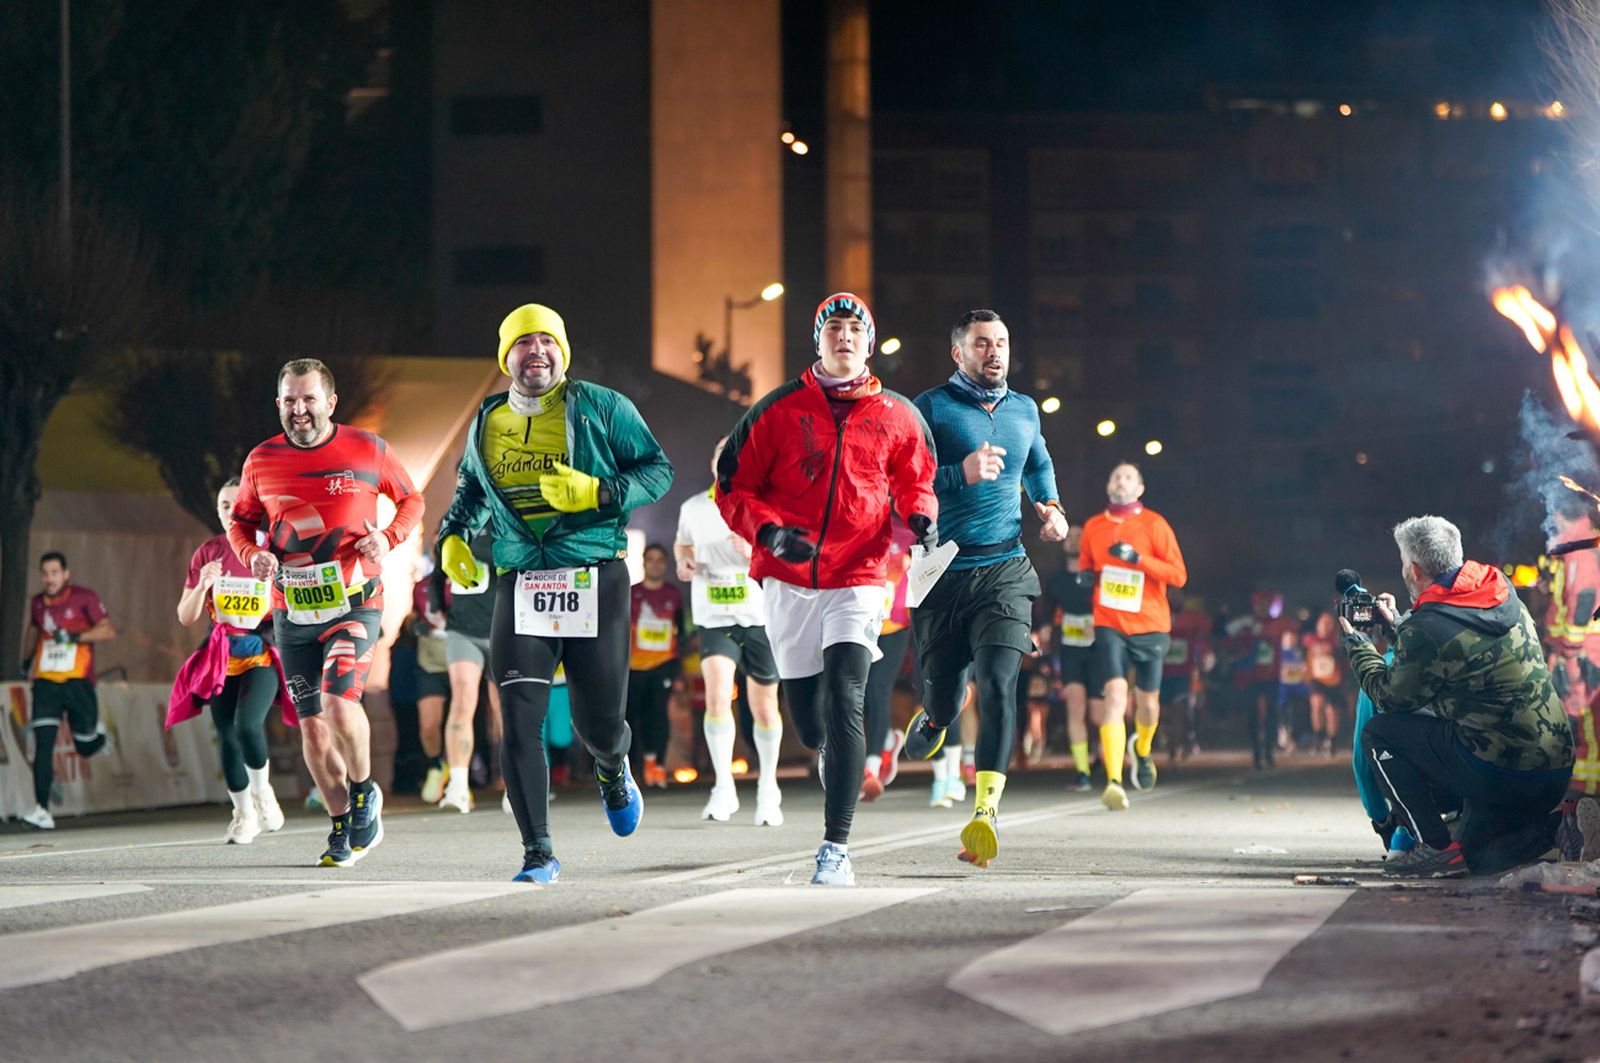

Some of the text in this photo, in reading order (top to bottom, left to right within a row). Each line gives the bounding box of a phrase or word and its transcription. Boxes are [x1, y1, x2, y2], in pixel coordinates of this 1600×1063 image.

[534, 573, 567, 581] NOCHE DE
[524, 582, 540, 590] SAN
[710, 586, 745, 600] 13443
[293, 585, 335, 605] 8009
[533, 591, 579, 613] 6718
[223, 595, 259, 612] 2326
